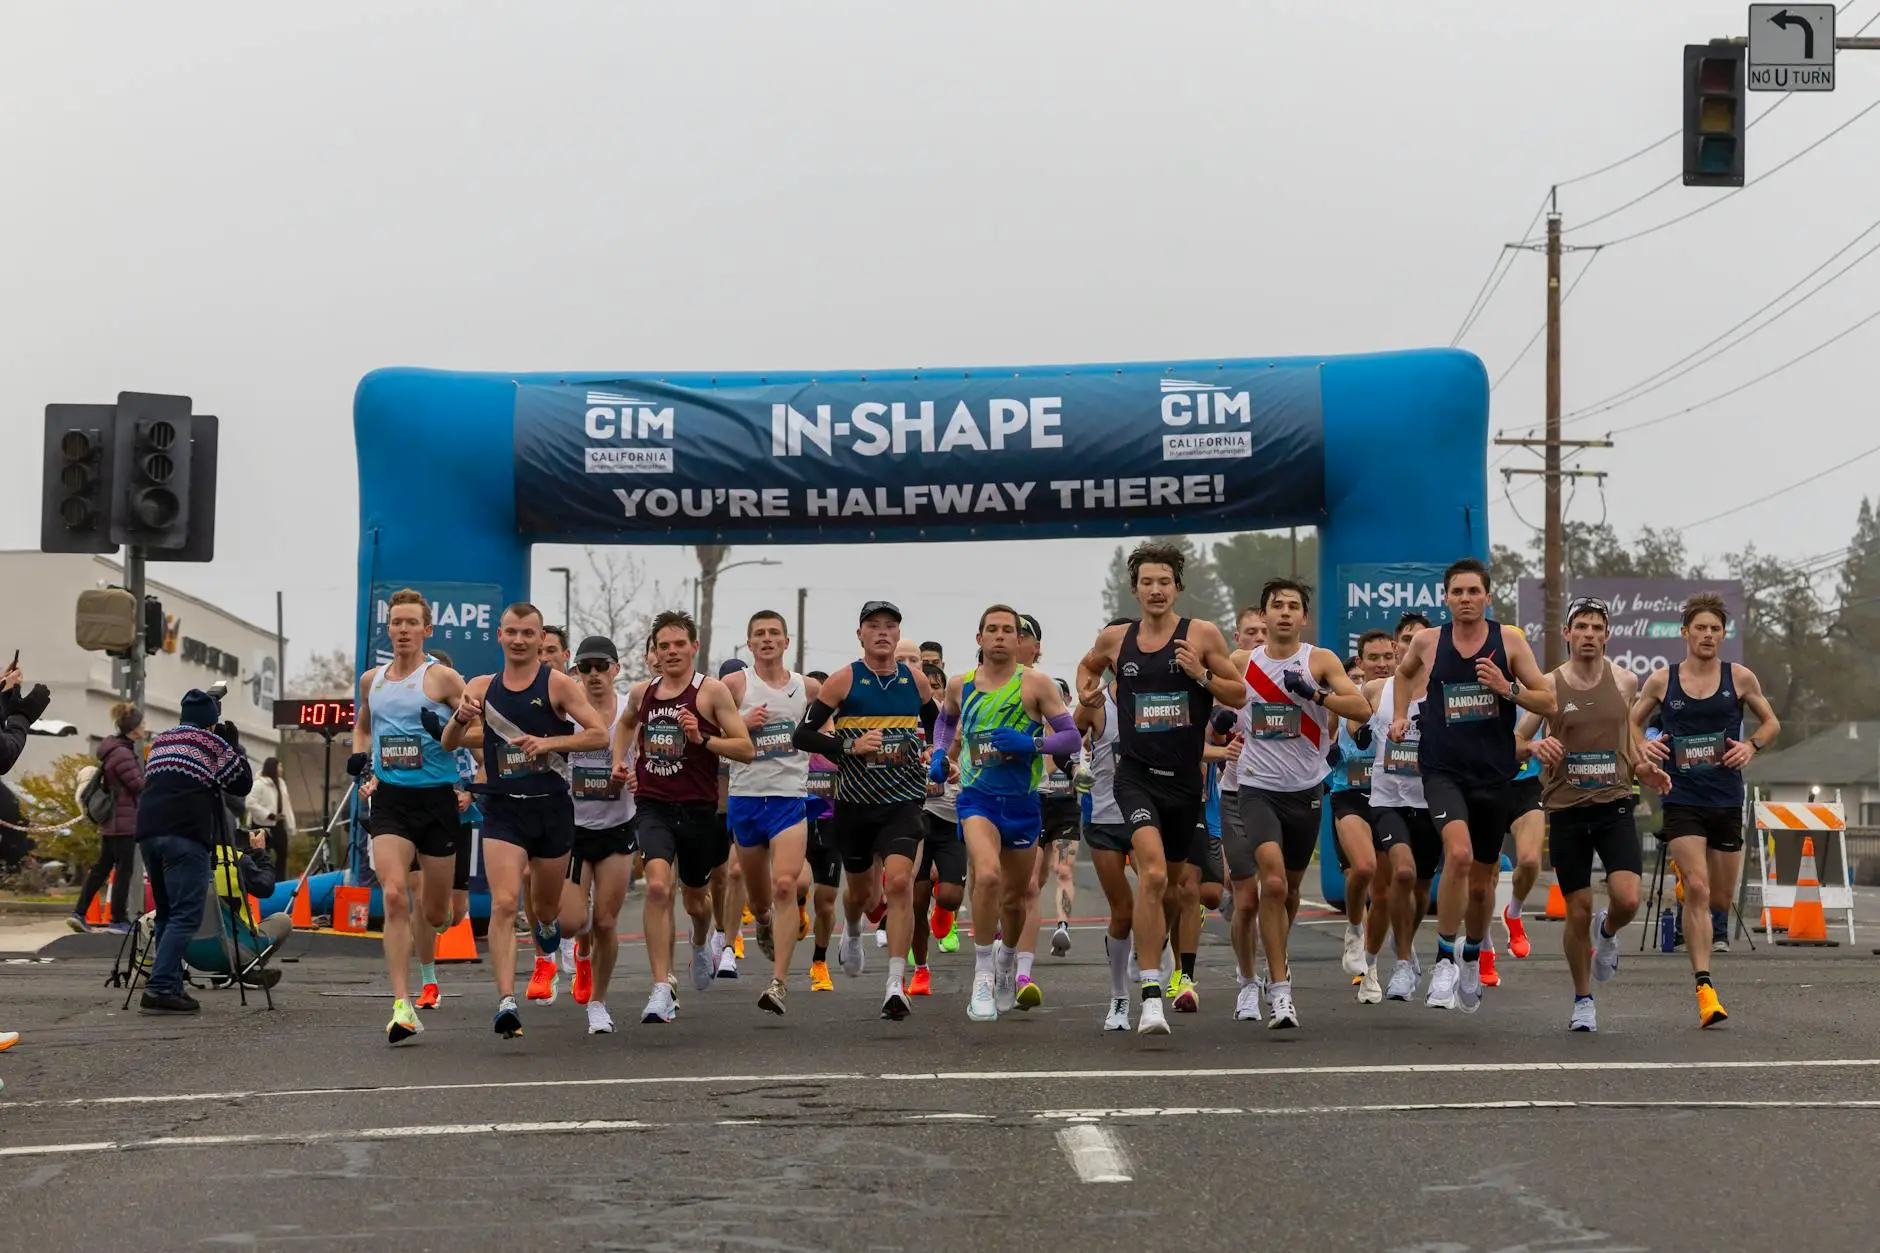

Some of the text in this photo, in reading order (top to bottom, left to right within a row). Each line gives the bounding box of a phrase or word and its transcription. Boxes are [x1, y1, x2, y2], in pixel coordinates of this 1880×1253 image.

[1752, 68, 1831, 87] NO U TURN
[1161, 391, 1252, 426] CIM
[585, 407, 674, 440] CIM
[771, 396, 1064, 457] IN-SHAPE
[1169, 436, 1245, 449] CALIFORNIA
[591, 452, 667, 462] CALIFORNIA
[612, 474, 1226, 517] YOU'RE HALFWAY THERE!
[1348, 582, 1445, 608] IN-SHAP
[1448, 694, 1494, 708] RANDAZZO
[1143, 704, 1181, 717] ROBERTS
[1265, 715, 1285, 726] RITZ
[650, 733, 674, 746] 466
[756, 733, 792, 747] MESSMER
[1685, 746, 1715, 759] HOUGH
[584, 778, 608, 789] DOUD
